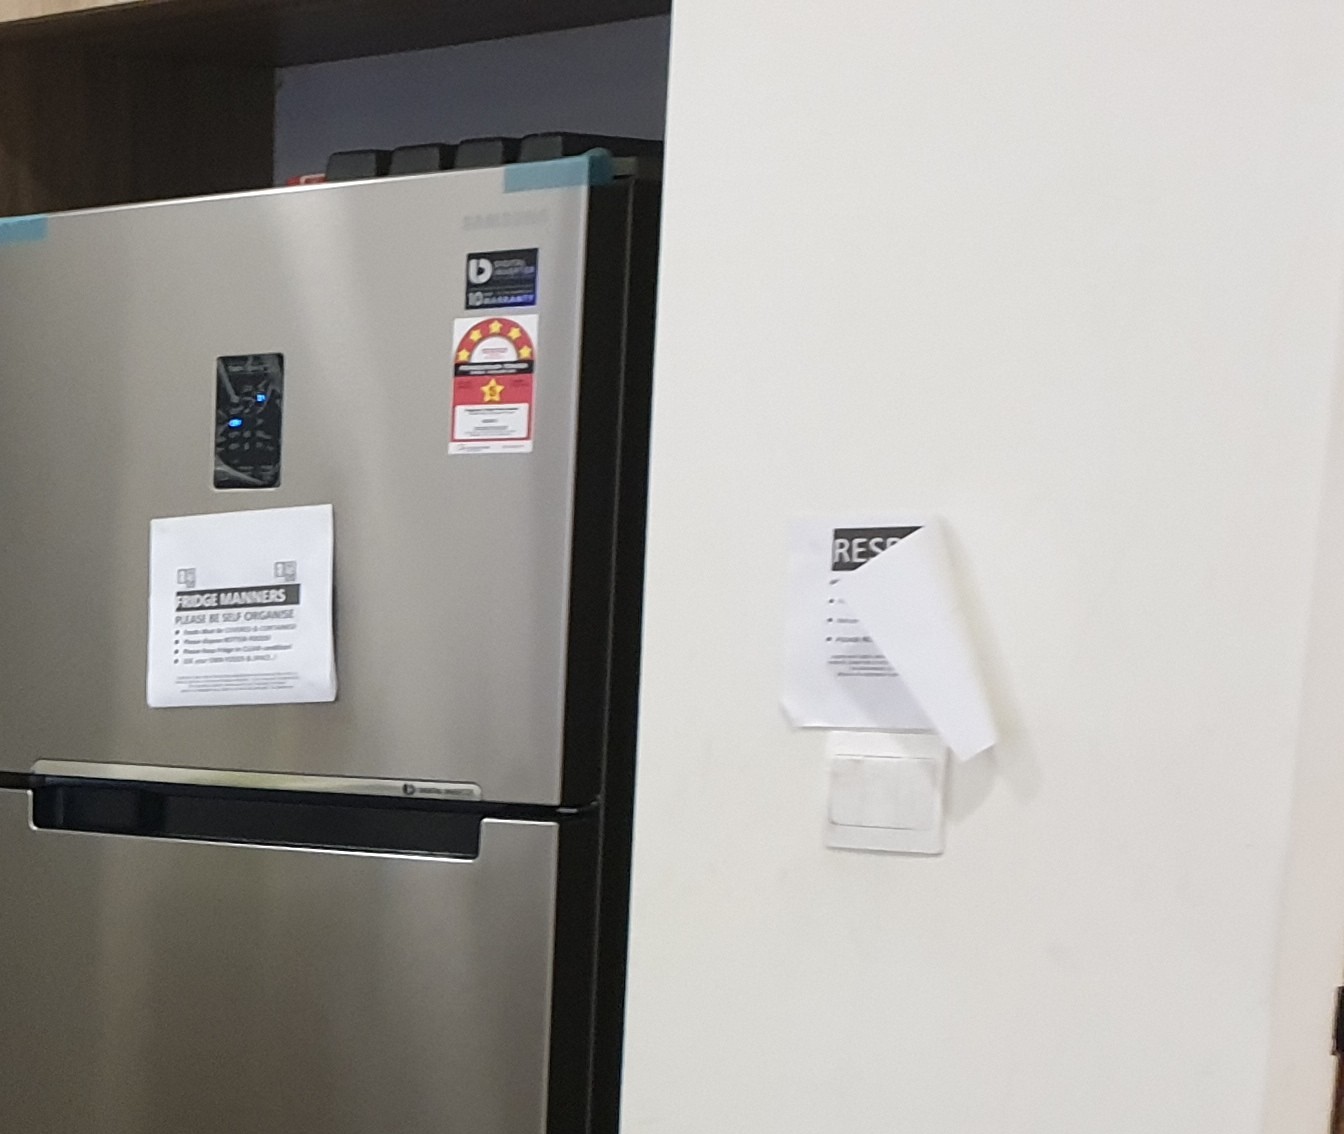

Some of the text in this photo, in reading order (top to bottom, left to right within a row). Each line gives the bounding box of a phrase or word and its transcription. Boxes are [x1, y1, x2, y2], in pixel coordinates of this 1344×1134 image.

[175, 588, 286, 609] FRIDGE MANNERS
[175, 613, 206, 625] PLEASE
[222, 611, 242, 623] SELF
[243, 608, 295, 621] ORGANISE
